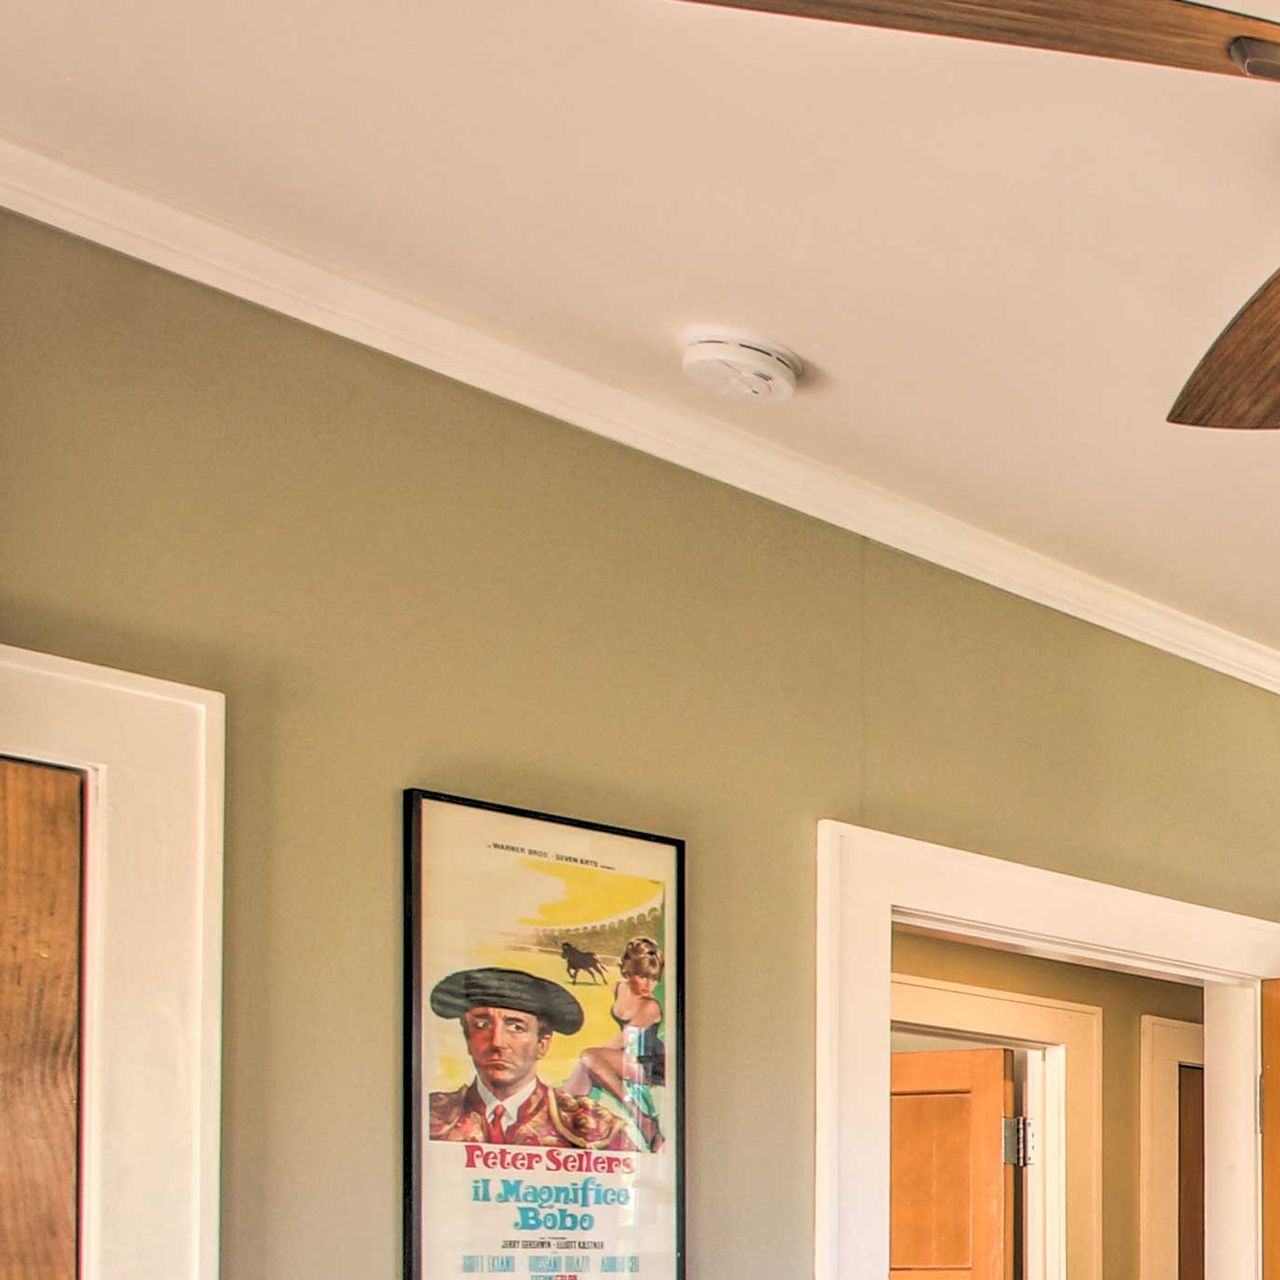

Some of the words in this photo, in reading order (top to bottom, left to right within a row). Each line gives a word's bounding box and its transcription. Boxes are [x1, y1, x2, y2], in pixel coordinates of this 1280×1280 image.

[464, 1144, 542, 1171] Peter
[545, 1148, 635, 1174] Sellers
[472, 1178, 491, 1202] il
[496, 1177, 630, 1209] Magnifico
[513, 1206, 594, 1231] Bobo
